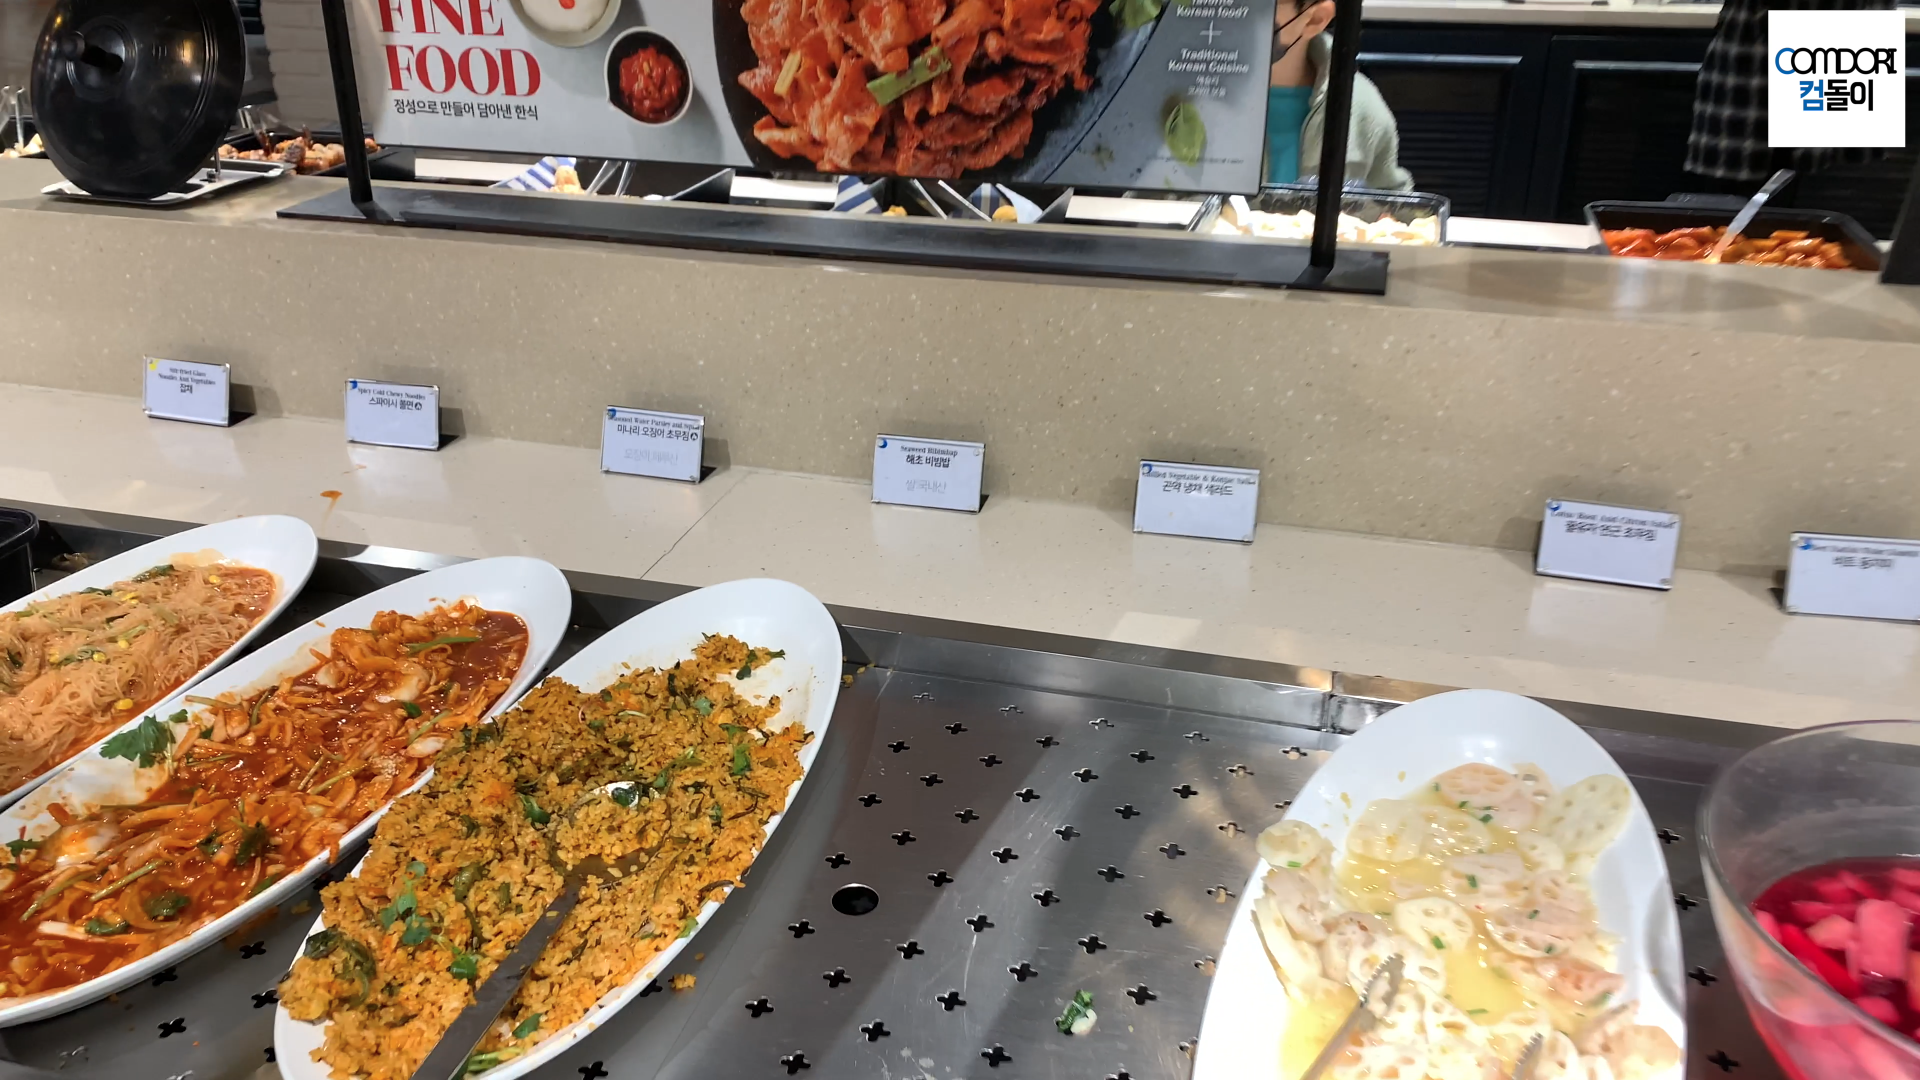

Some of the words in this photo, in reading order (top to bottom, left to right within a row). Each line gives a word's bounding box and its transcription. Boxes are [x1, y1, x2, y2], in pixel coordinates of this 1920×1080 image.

[379, 0, 504, 36] FINE
[1176, 5, 1216, 18] Korean
[1217, 6, 1250, 19] food?
[1180, 48, 1239, 61] Traditional
[382, 44, 541, 97] FOOD
[1167, 59, 1207, 73] Korean
[1208, 60, 1250, 75] Cuisine
[394, 98, 440, 115] 정성으로
[440, 100, 475, 118] 만들어
[477, 103, 513, 120] 담아낸
[515, 104, 539, 121] 한식
[368, 396, 398, 409] 스파이시
[404, 392, 426, 401] Noodles
[634, 417, 650, 425] Water
[672, 421, 683, 429] and
[617, 424, 640, 436] 미나리
[641, 426, 665, 439] 오징어
[666, 429, 690, 442] 초무침
[900, 445, 926, 454] Seaweed
[906, 454, 924, 465] 해초
[925, 456, 951, 469] 비빔밥
[1168, 471, 1201, 482] Vegetable
